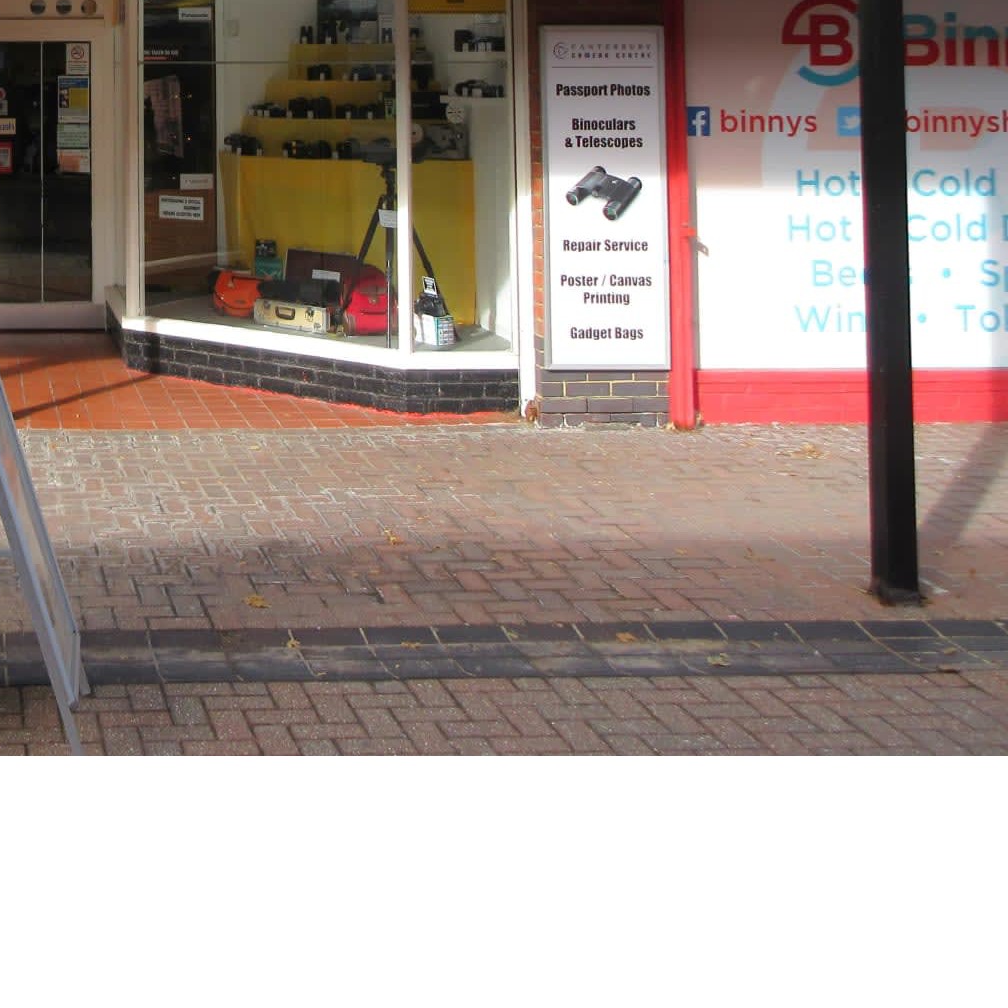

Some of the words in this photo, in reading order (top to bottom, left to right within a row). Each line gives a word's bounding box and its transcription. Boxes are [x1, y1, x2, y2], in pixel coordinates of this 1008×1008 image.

[555, 83, 608, 98] Passport
[610, 84, 651, 96] Photos
[571, 118, 636, 131] Binoculars
[720, 110, 818, 137] binnys
[564, 137, 573, 148] &
[575, 135, 643, 149] Telescopes
[796, 169, 860, 196] Hot
[912, 168, 997, 196] Cold
[788, 215, 852, 242] Hot
[907, 213, 988, 242] Cold
[563, 239, 601, 252] Repair
[604, 239, 649, 252] Service
[560, 274, 599, 287] Poster
[609, 274, 652, 287] Canvas
[583, 291, 630, 305] Printing
[570, 327, 612, 340] Gadget
[614, 327, 644, 340] Bags
